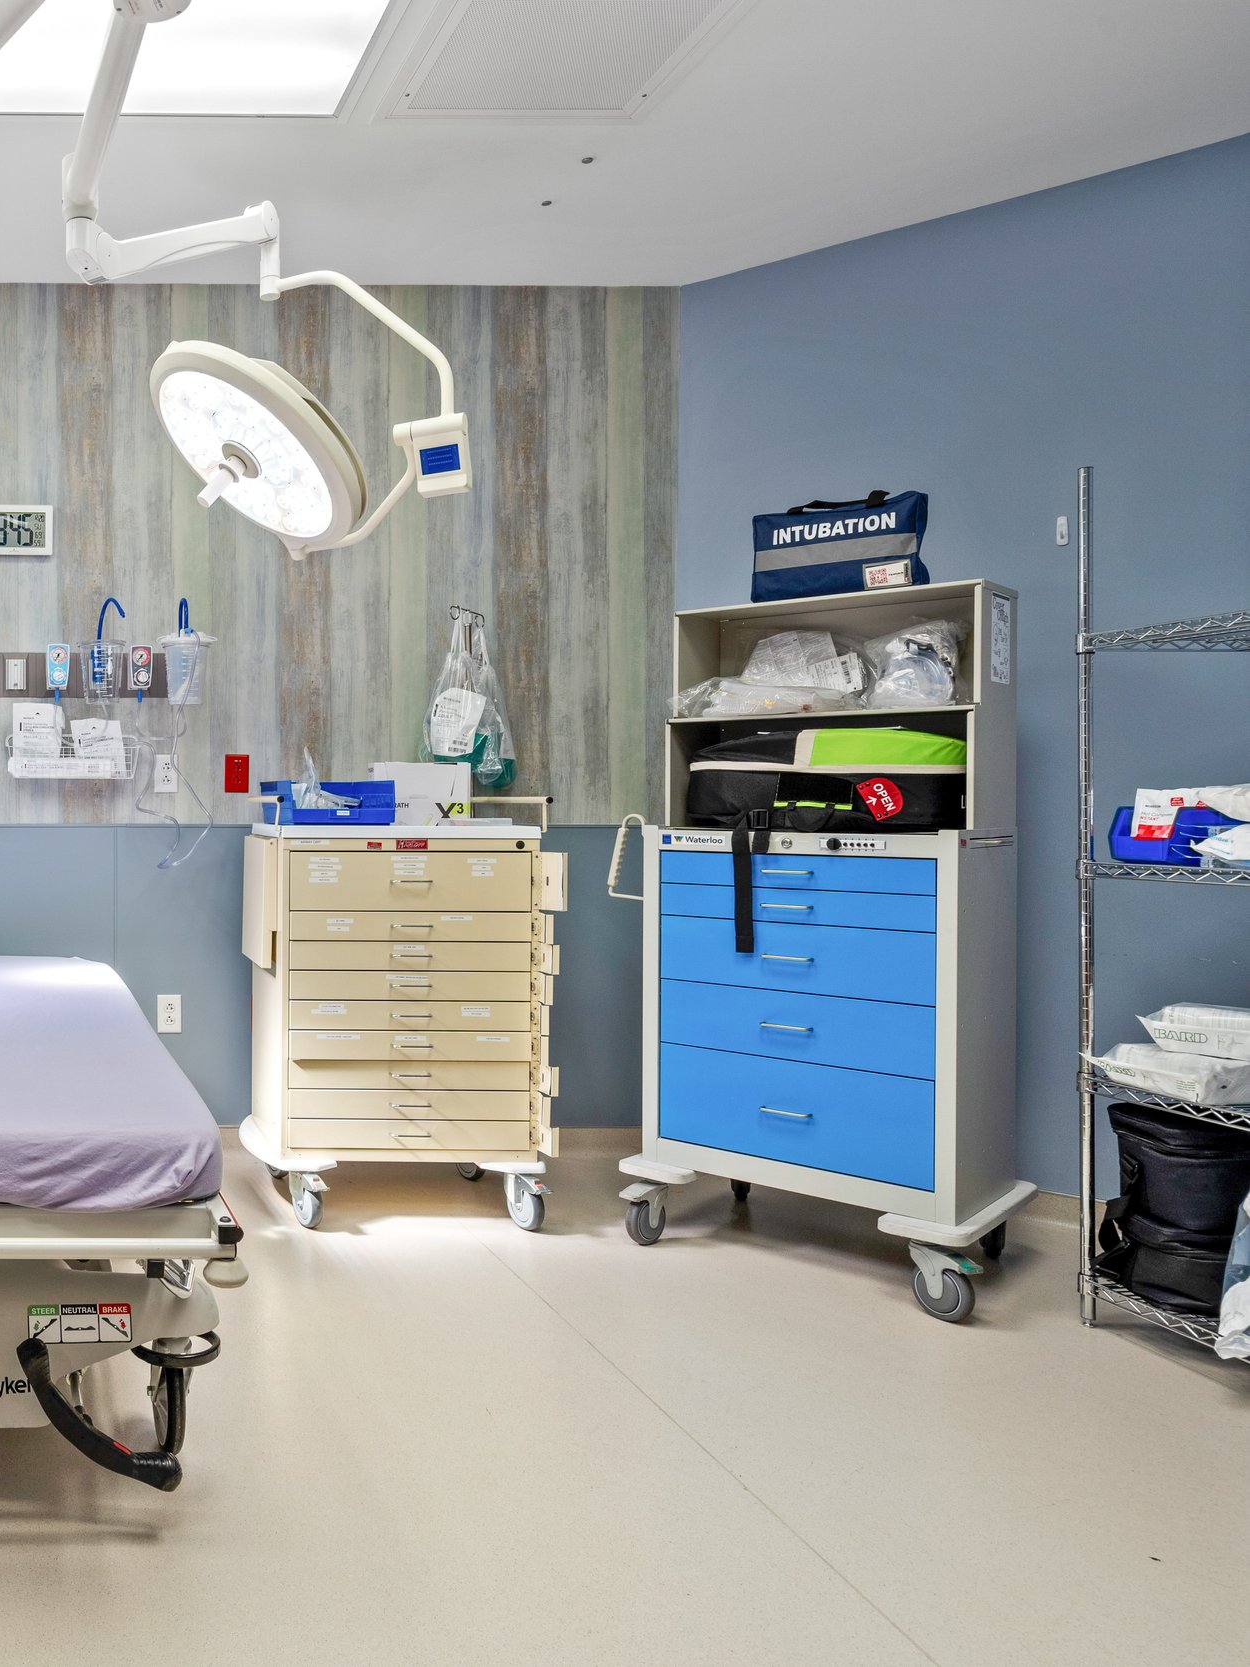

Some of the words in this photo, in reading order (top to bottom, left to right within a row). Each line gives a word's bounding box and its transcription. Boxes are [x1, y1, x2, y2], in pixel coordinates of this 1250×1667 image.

[772, 512, 896, 546] INTUBATION
[873, 783, 897, 811] OPEN
[685, 836, 723, 844] Waterloo
[1154, 1028, 1208, 1043] BARD
[31, 1307, 56, 1315] STEER
[62, 1306, 96, 1314] NEUTRAL
